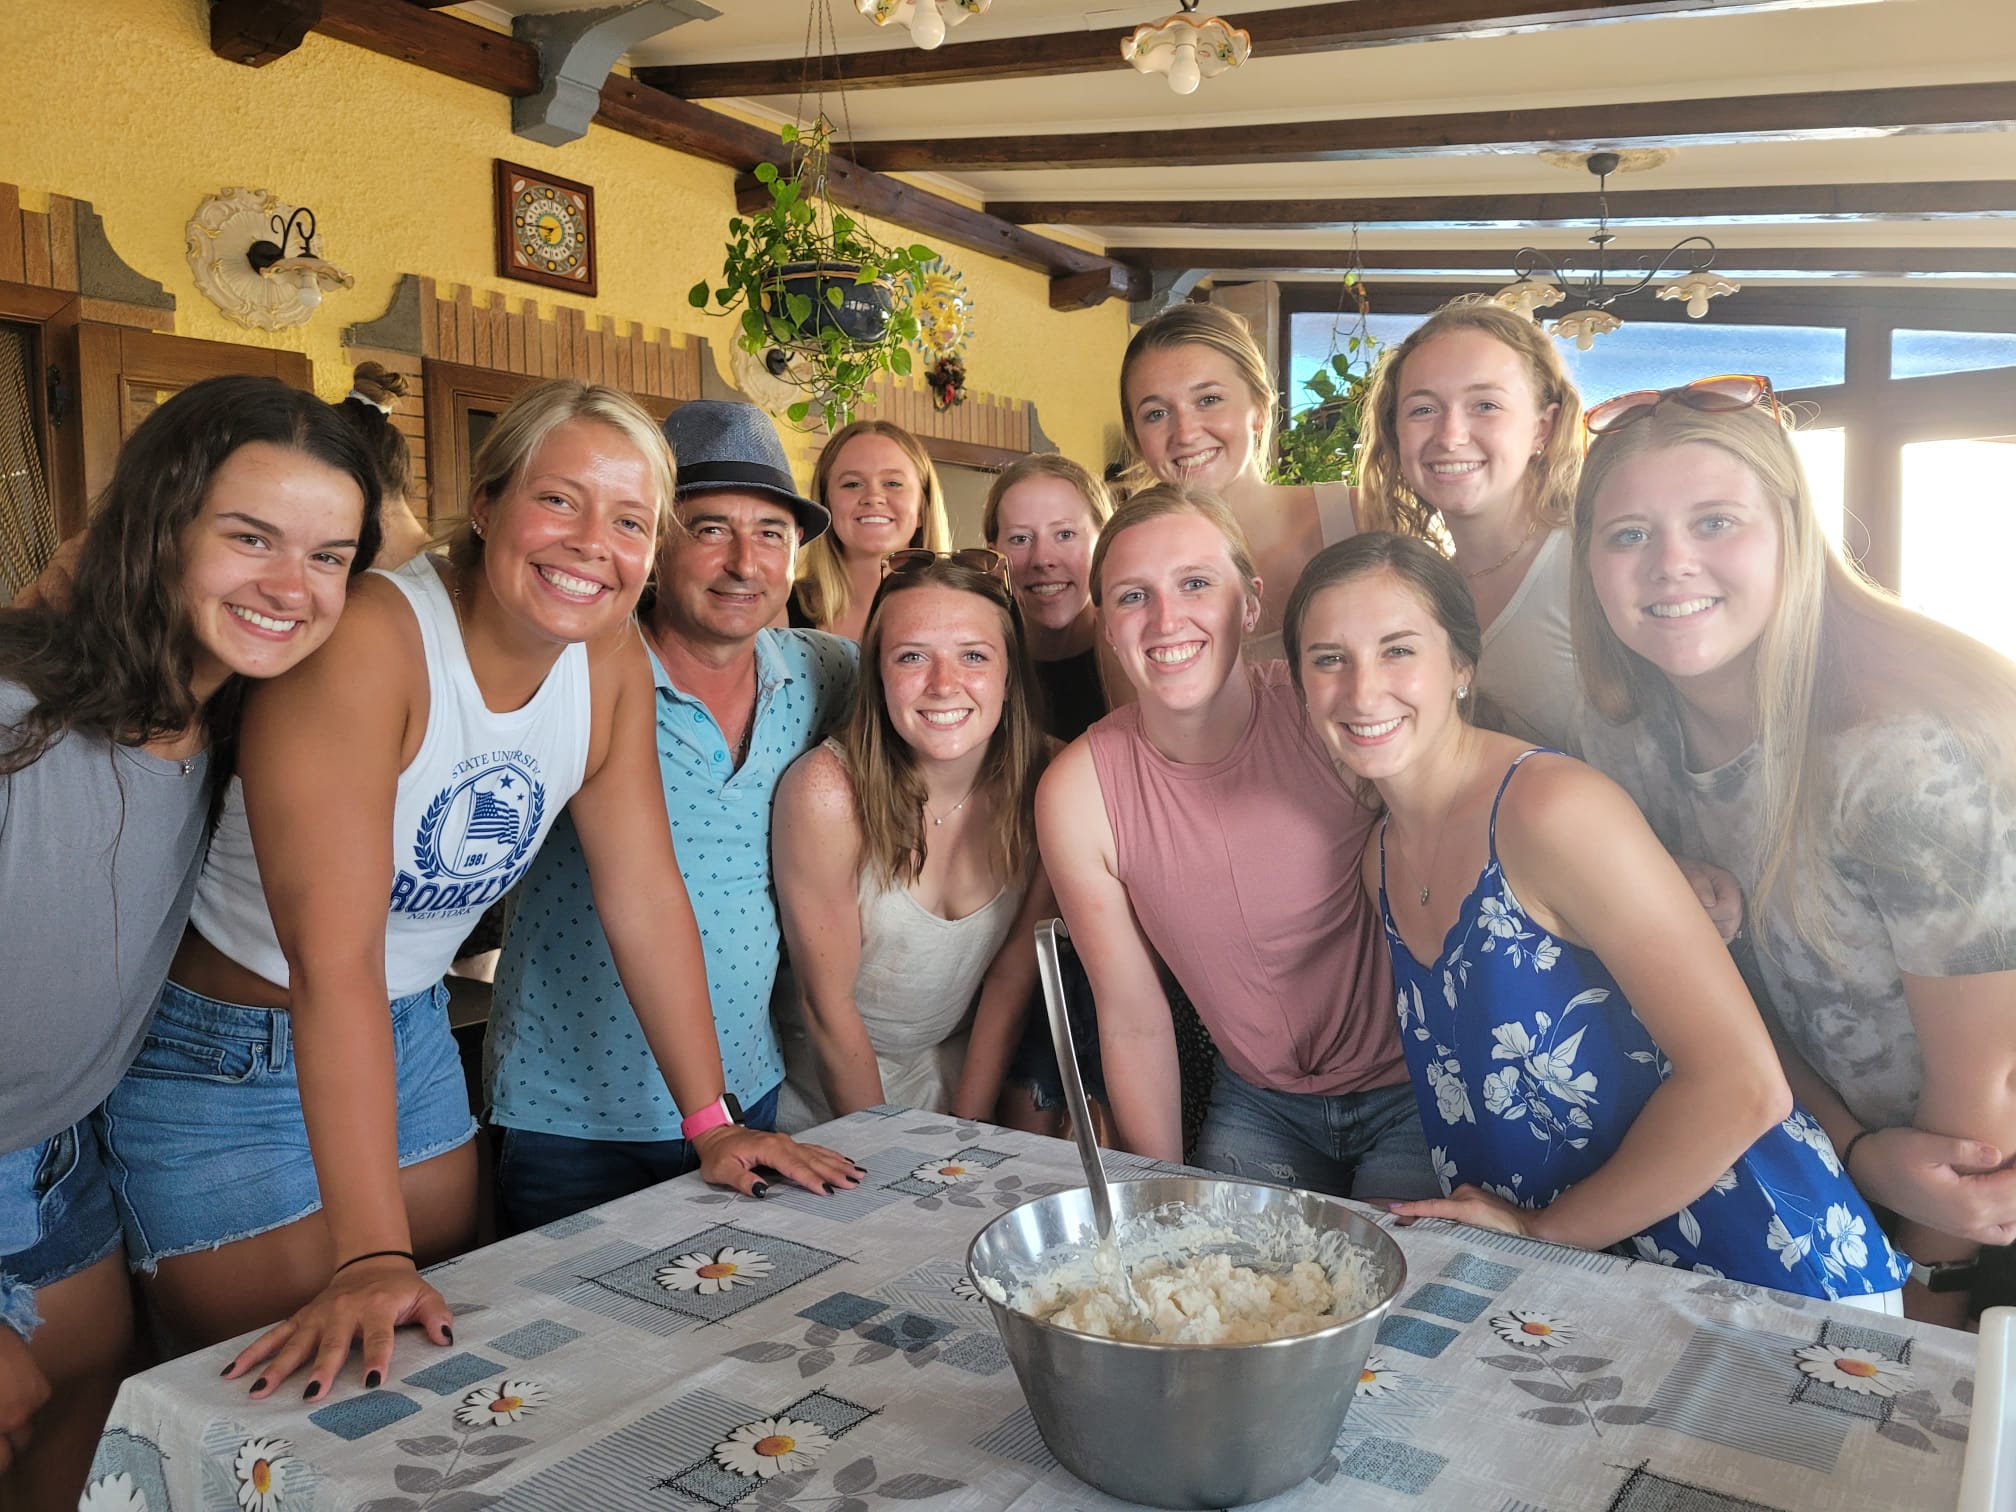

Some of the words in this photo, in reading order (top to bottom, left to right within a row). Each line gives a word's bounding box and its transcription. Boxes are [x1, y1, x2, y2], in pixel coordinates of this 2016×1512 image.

[452, 753, 490, 779] STATE
[463, 852, 488, 868] 1981
[390, 860, 531, 913] ROOKLY
[406, 910, 439, 920] NEW
[440, 905, 473, 919] YORK
